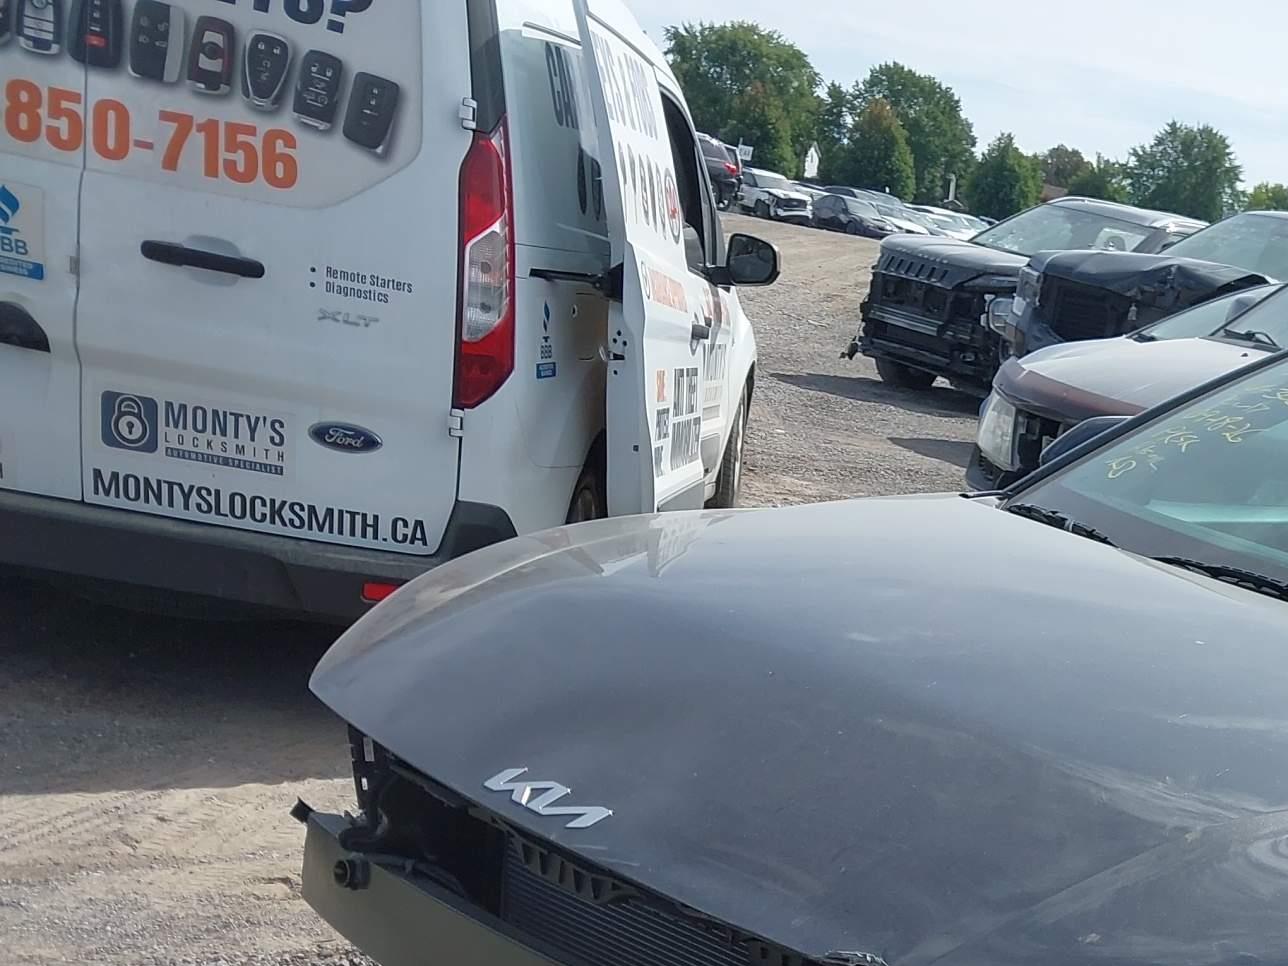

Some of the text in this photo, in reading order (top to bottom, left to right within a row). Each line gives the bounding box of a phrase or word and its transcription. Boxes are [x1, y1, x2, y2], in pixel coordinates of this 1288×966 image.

[5, 78, 298, 189] 850-7156
[0, 236, 29, 256] BB
[325, 281, 389, 304] Diagnostics
[326, 266, 413, 294] Remote Starters
[318, 307, 379, 328] XLT
[164, 400, 285, 448] MONTY'S
[324, 427, 365, 448] Ford
[164, 432, 285, 462] LOCKSMITH
[92, 467, 428, 547] MONTYSLOCKSMITH.CA
